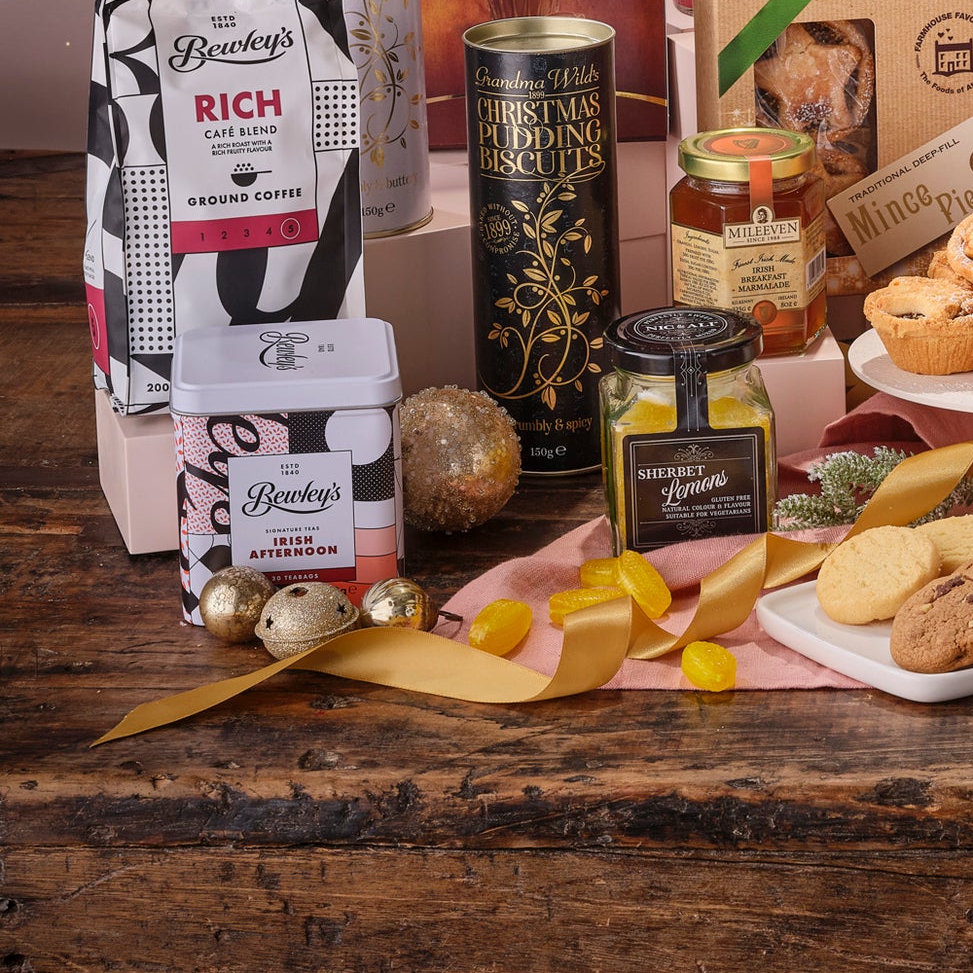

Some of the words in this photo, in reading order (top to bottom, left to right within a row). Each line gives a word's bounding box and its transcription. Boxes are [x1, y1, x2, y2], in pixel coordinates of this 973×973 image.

[212, 21, 237, 29] 1840
[914, 12, 953, 53] FARMHOUSE
[168, 27, 294, 73] Bewley's
[474, 66, 545, 90] Grandma
[547, 63, 600, 91] Wild's
[919, 70, 932, 84] The
[931, 81, 955, 94] Foods
[528, 91, 545, 100] 1899
[194, 89, 283, 123] RICH
[477, 91, 601, 125] CHRISTMAS
[204, 126, 235, 139] CAFÉ
[240, 125, 278, 137] BLEND
[478, 118, 601, 151] PUDDING
[226, 147, 246, 155] FRUITY
[246, 145, 272, 154] FLAVOUR
[479, 143, 604, 176] BISCUITS
[848, 165, 912, 204] TRADITIONAL
[912, 138, 961, 168] DEEP-FILL
[187, 193, 249, 207] GROUND
[254, 187, 303, 201] COFFEE
[844, 183, 934, 246] Mince
[484, 219, 511, 239] 1899
[728, 221, 798, 240] MILEEVEN
[741, 272, 787, 283] BREAKFAST
[752, 265, 775, 274] IRISH
[738, 281, 790, 293] MARMALADE
[638, 465, 706, 480] SHERBET
[661, 469, 729, 507] Lemons
[241, 480, 341, 518] Bewley's
[709, 508, 752, 517] VEGETARIANS
[273, 535, 314, 546] IRISH
[249, 545, 338, 560] AFTERNOON
